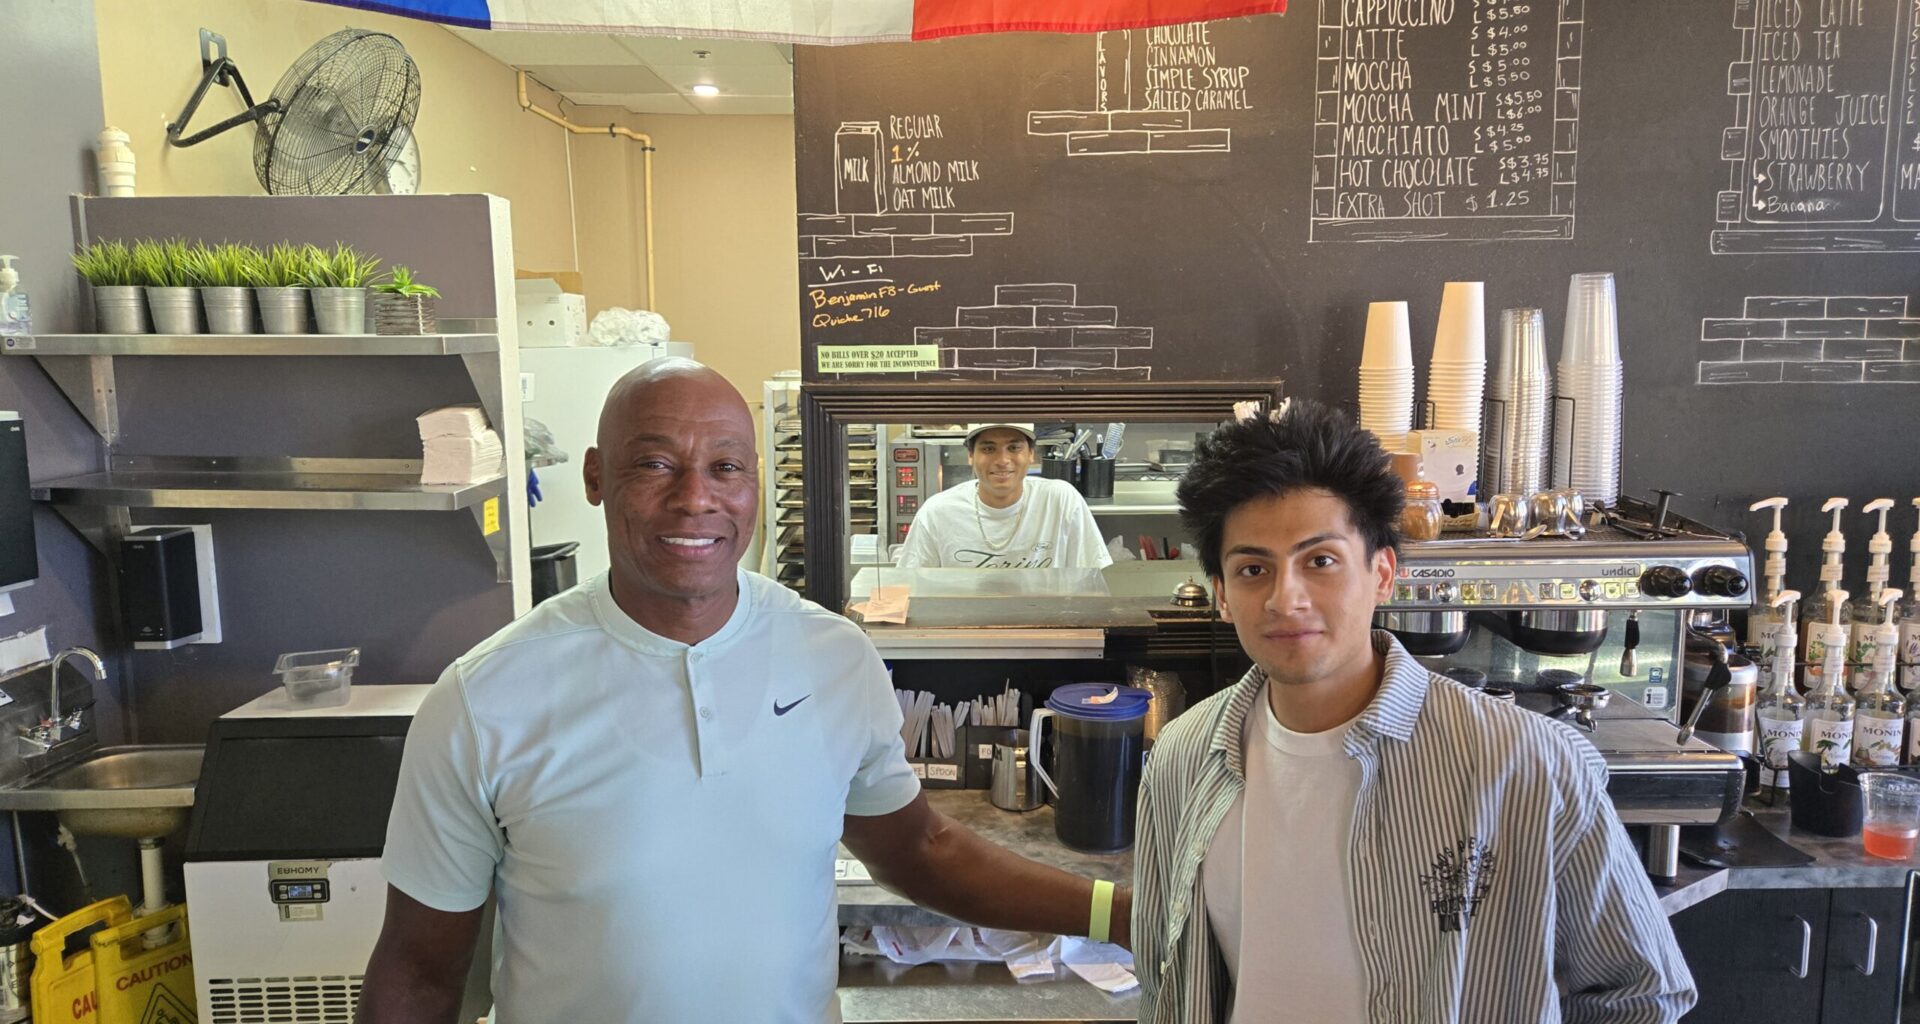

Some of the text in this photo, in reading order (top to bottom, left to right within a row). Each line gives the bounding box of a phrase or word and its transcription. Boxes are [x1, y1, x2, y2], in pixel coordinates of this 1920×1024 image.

[1345, 0, 1455, 27] CAPPUCCINO
[1764, 0, 1864, 28] ICED LATTE
[1146, 21, 1210, 46] CHOCOLATE
[1345, 29, 1407, 61] LATTE
[1761, 31, 1840, 61] ICED TEA
[1146, 46, 1215, 68] CINNAMON
[1145, 66, 1250, 90] SIMPLE SYRUP
[1344, 61, 1411, 91] MOCCHA
[1761, 65, 1834, 94] LEMONADE
[1143, 88, 1253, 111] SALTED CARAMEL
[1342, 93, 1413, 124] MOCCHA
[1435, 92, 1487, 123] MINT
[1759, 94, 1887, 127] ORANGE JUICE
[890, 114, 943, 139] REGULAR
[1341, 125, 1449, 156] MACCHIATO
[1758, 128, 1850, 160] SMOOTHIES
[844, 156, 869, 183] MILK
[892, 160, 980, 184] ALMOND MILK
[1340, 157, 1478, 189] HOT CHOCOLATE
[1765, 161, 1870, 192] STRAWBERRY
[893, 186, 956, 211] OAT MILK
[1337, 192, 1385, 218] EXTRA
[1403, 191, 1446, 218] SHOT
[1766, 196, 1825, 214] Banana
[821, 350, 919, 360] NO BILLS OVER $20 ACCEPTED
[893, 360, 936, 368] INCONVENIENCE
[1412, 568, 1455, 578] CASADIO
[929, 766, 955, 777] SPOON
[277, 866, 319, 875] EUHOMY
[116, 953, 193, 992] CAUTION
